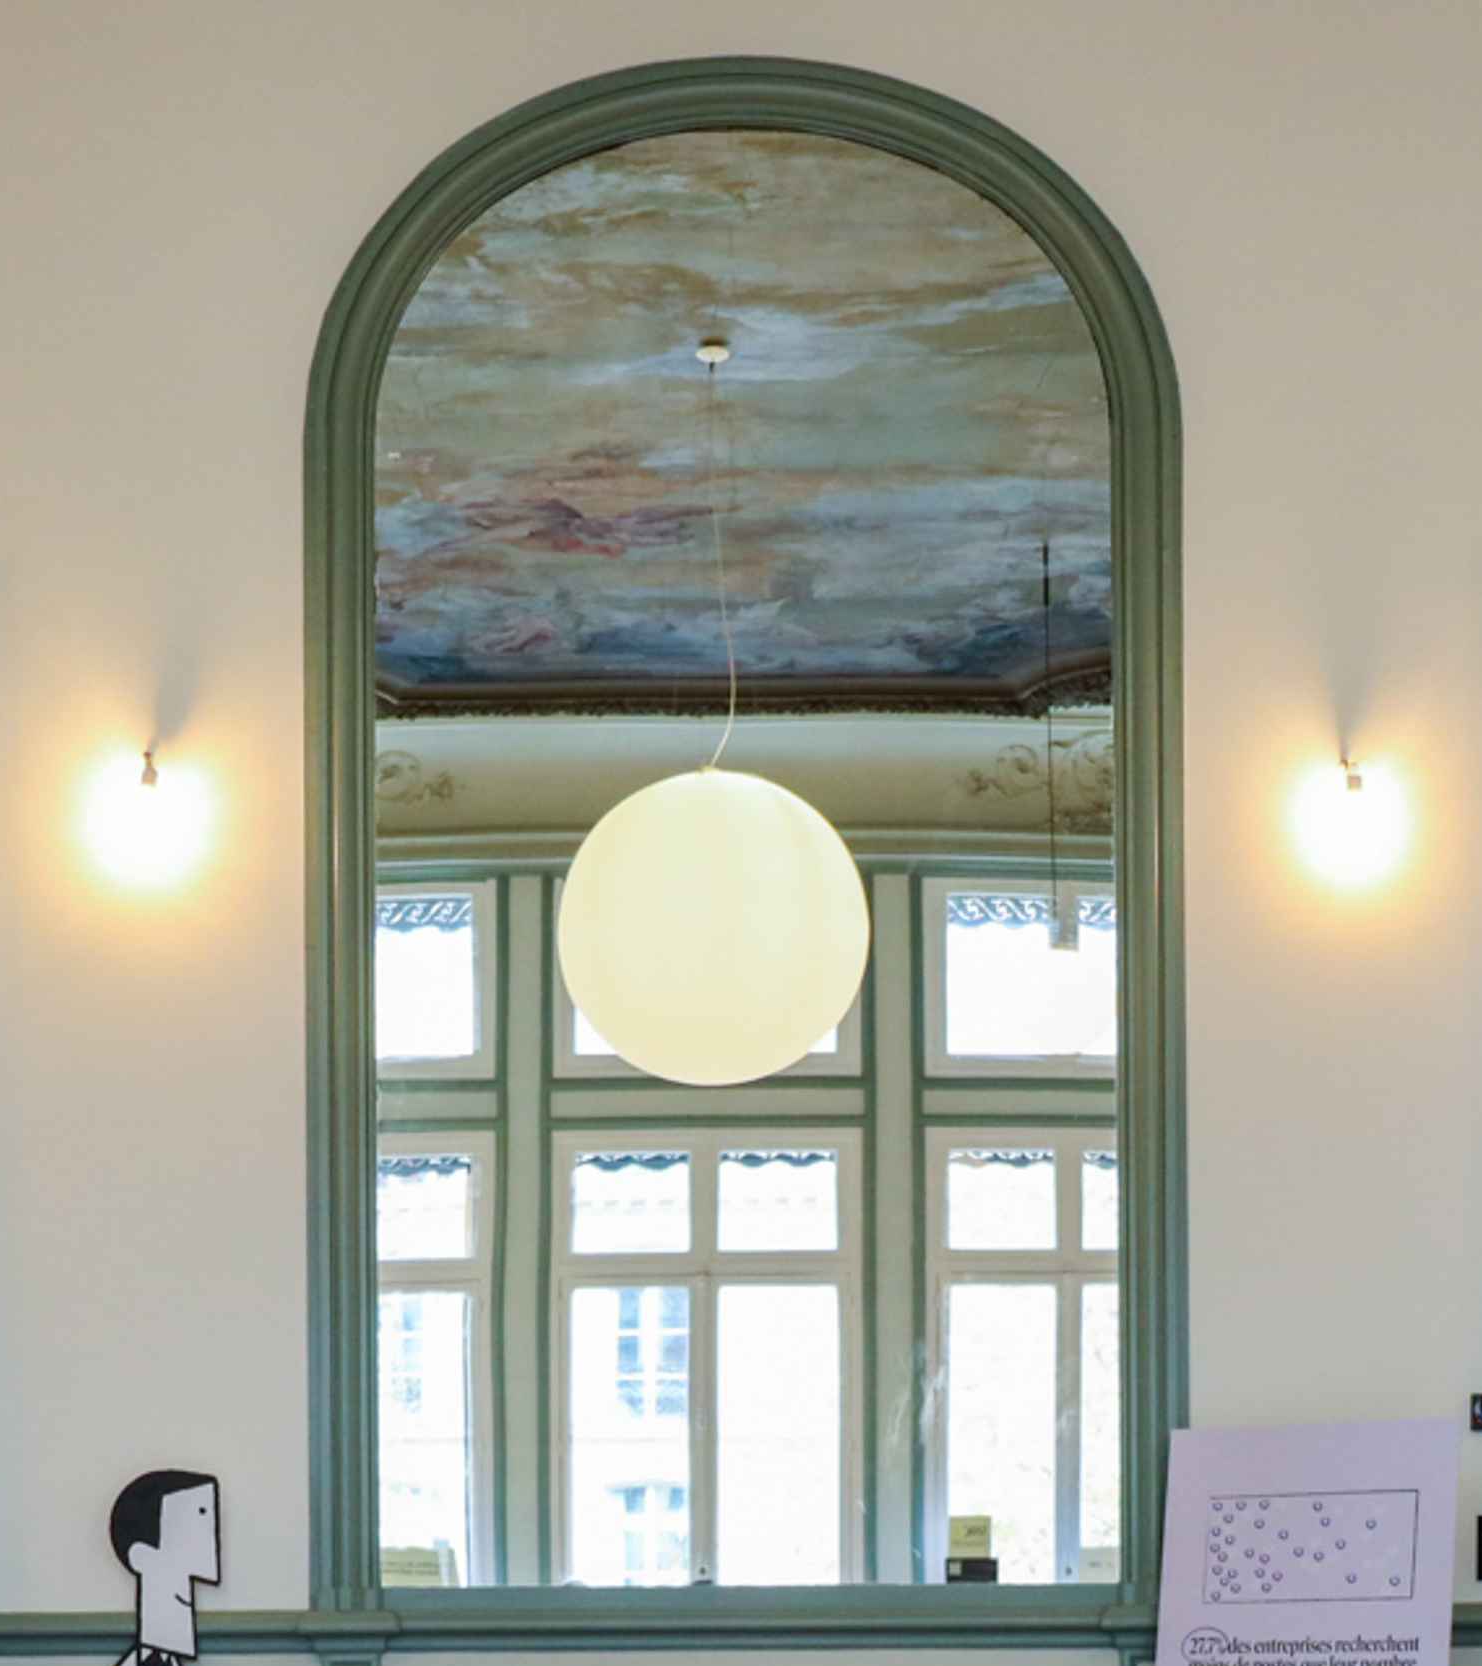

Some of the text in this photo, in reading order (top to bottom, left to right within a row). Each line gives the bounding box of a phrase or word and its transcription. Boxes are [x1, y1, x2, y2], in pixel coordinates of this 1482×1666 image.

[1227, 1636, 1252, 1655] des
[1254, 1636, 1333, 1657] entreprises
[1334, 1634, 1421, 1653] recherchent
